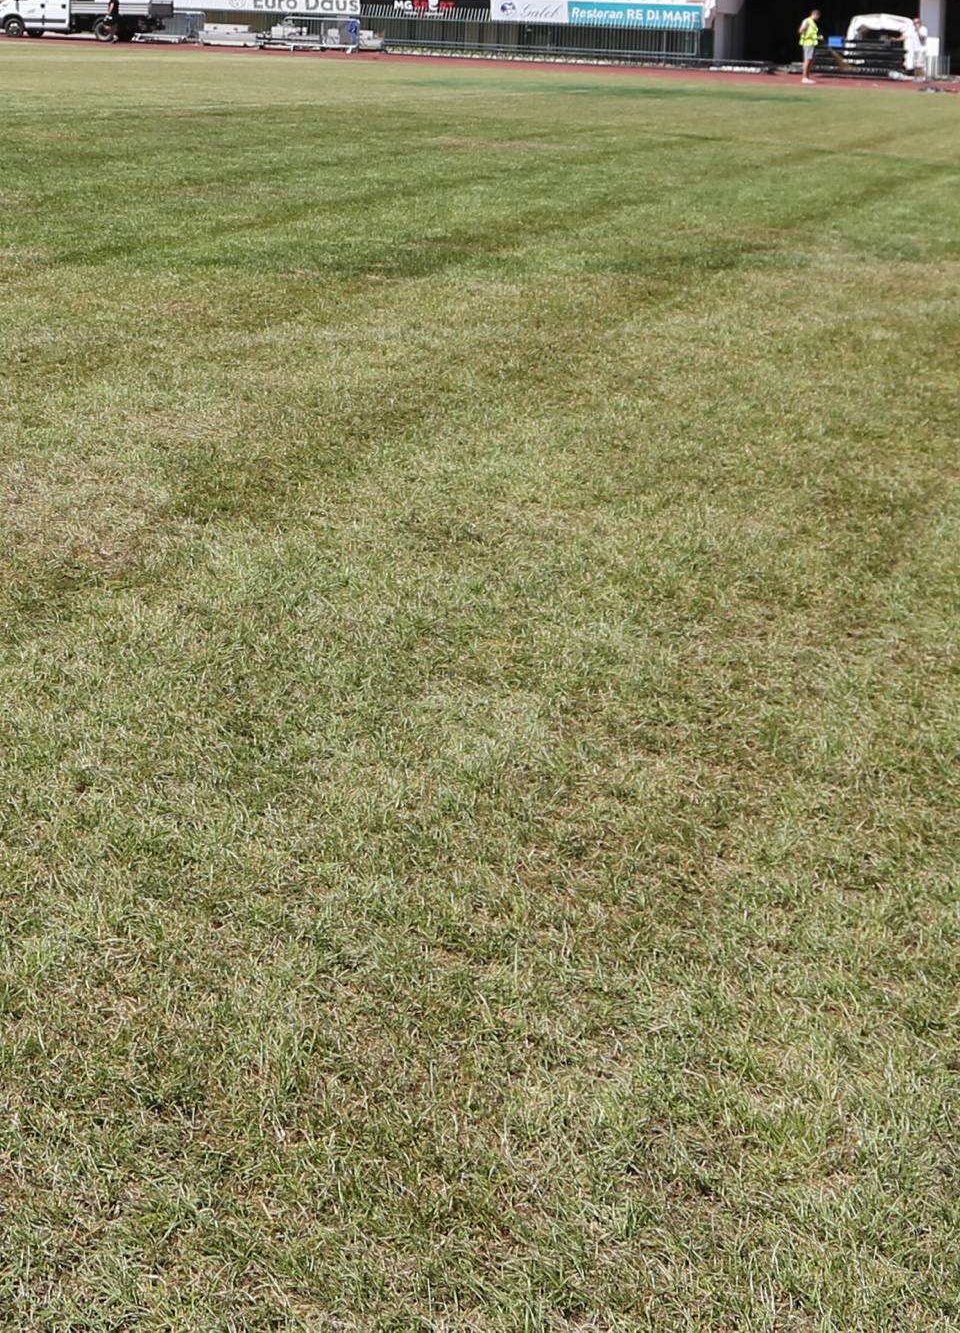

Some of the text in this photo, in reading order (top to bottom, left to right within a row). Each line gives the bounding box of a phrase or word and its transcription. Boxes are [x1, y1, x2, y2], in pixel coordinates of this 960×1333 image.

[571, 7, 700, 22] Restoran RE DI MARE
